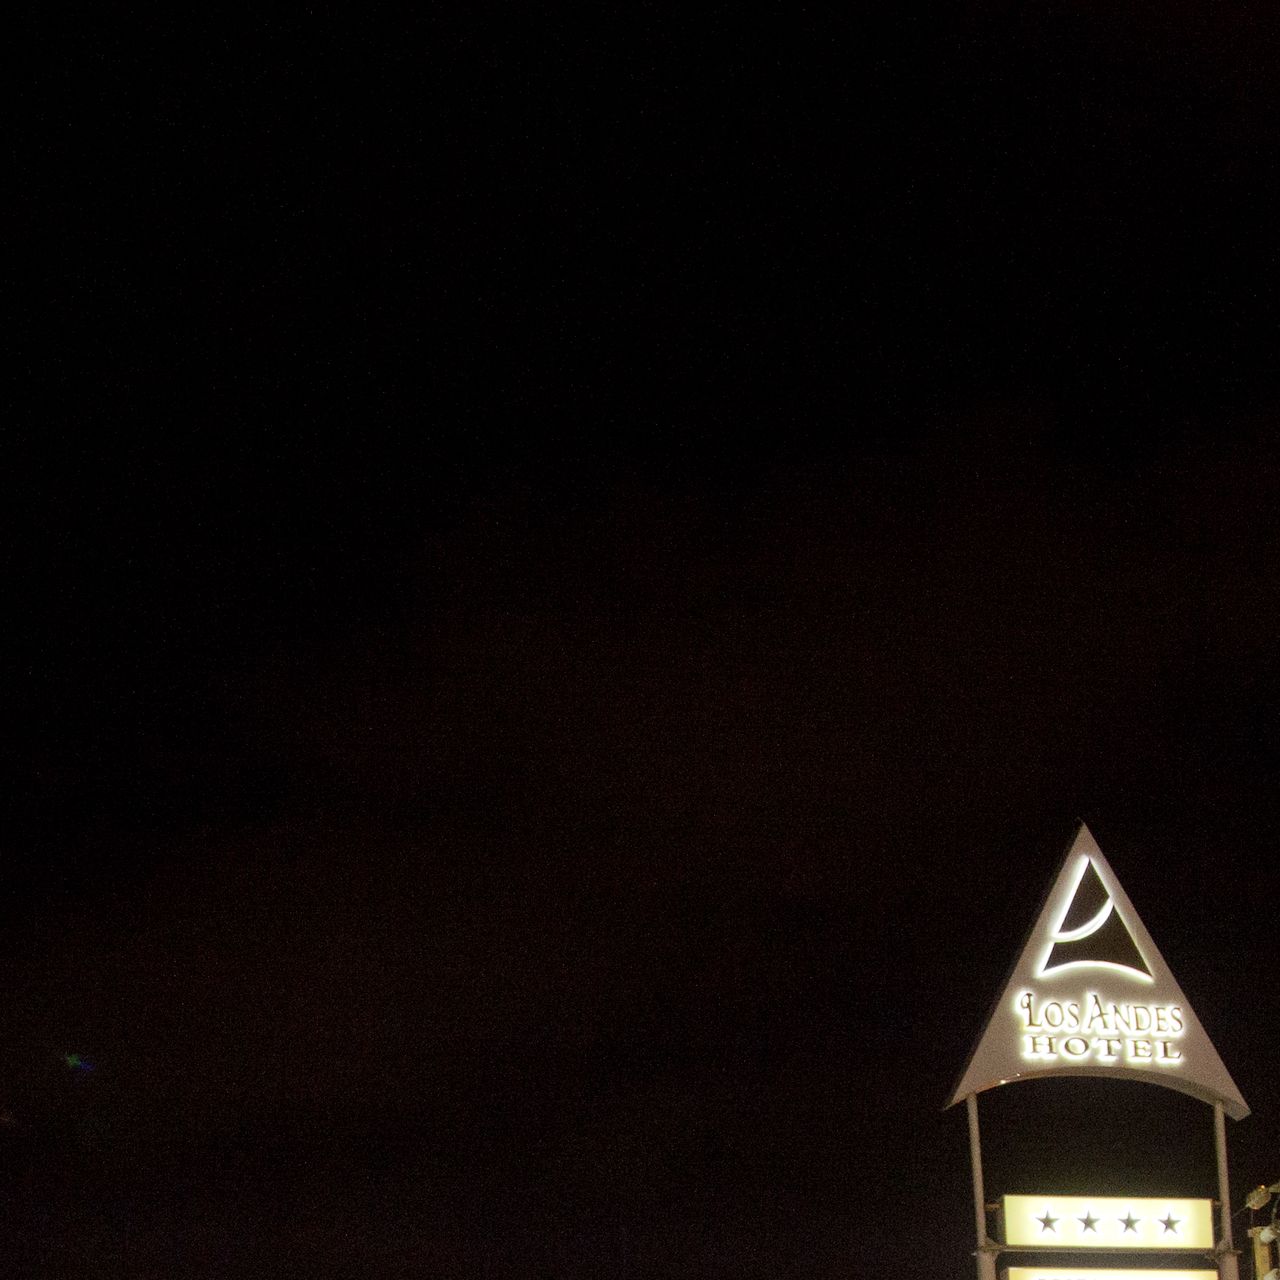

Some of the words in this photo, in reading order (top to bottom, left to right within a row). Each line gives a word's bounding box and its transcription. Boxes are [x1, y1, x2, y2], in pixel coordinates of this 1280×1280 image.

[1019, 991, 1080, 1029] LOS
[1087, 994, 1184, 1033] ANDES
[1029, 1035, 1183, 1060] HOTEL
